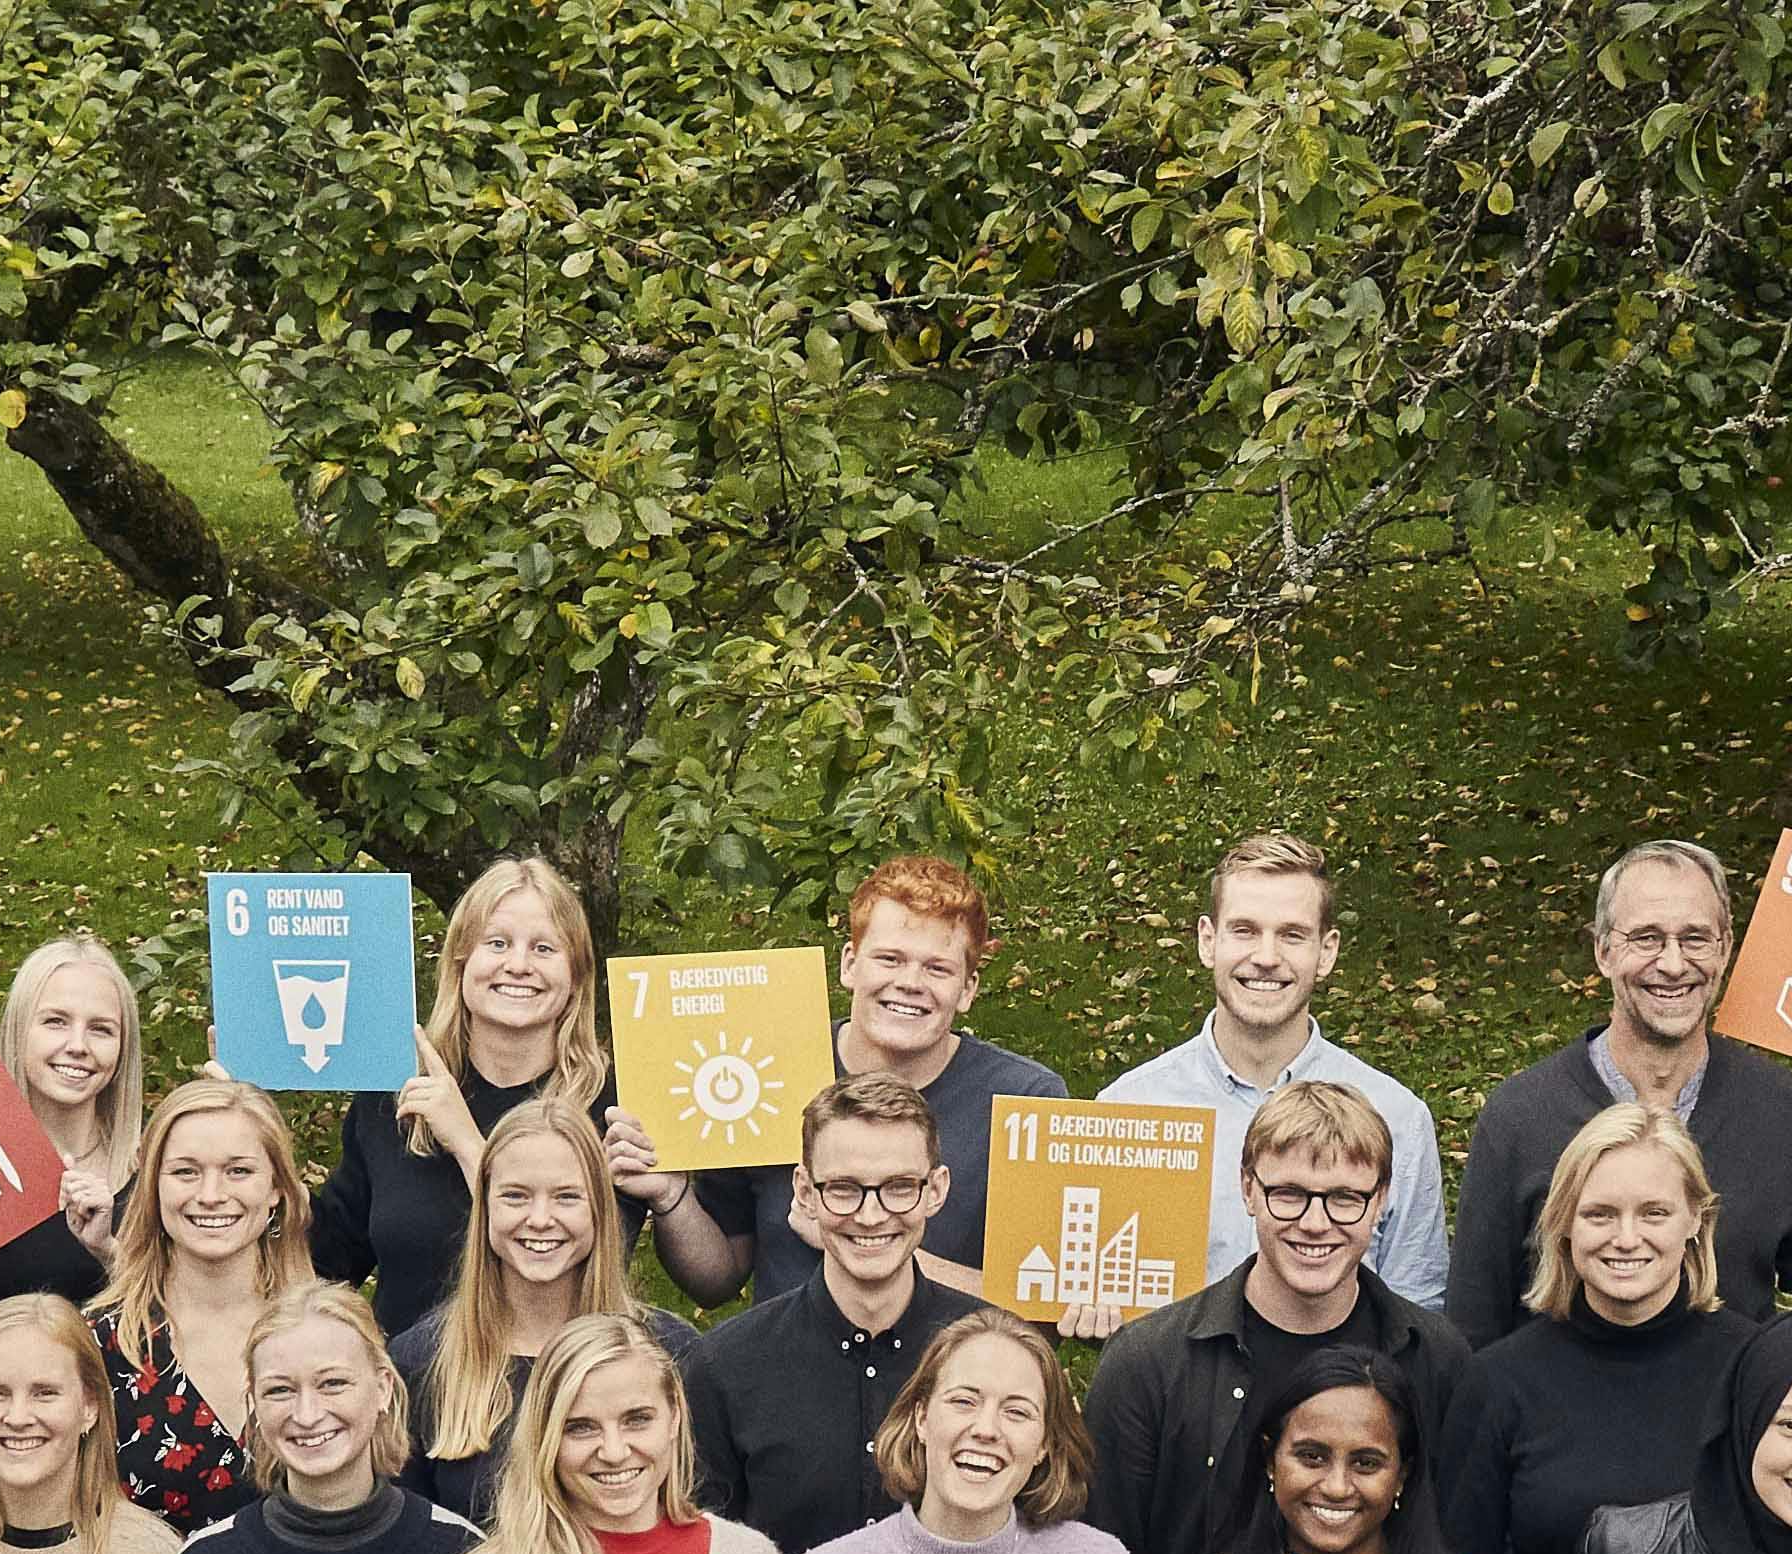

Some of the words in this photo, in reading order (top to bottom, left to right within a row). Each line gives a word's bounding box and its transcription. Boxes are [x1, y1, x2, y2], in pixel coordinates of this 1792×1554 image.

[226, 888, 250, 936] 6
[266, 889, 302, 909] RENT
[303, 889, 344, 909] VAND
[268, 916, 289, 936] OG
[291, 916, 350, 937] SANITET
[669, 965, 769, 989] BÆREDYGTIG
[627, 971, 649, 1019] 7
[671, 994, 725, 1017] ENERGI
[1004, 1112, 1039, 1161] 11
[1049, 1114, 1160, 1141] BÆREDYGTIGE
[1163, 1121, 1204, 1143] BYER
[1048, 1143, 1070, 1163] OG
[1074, 1145, 1199, 1170] LOKALSAMFUND
